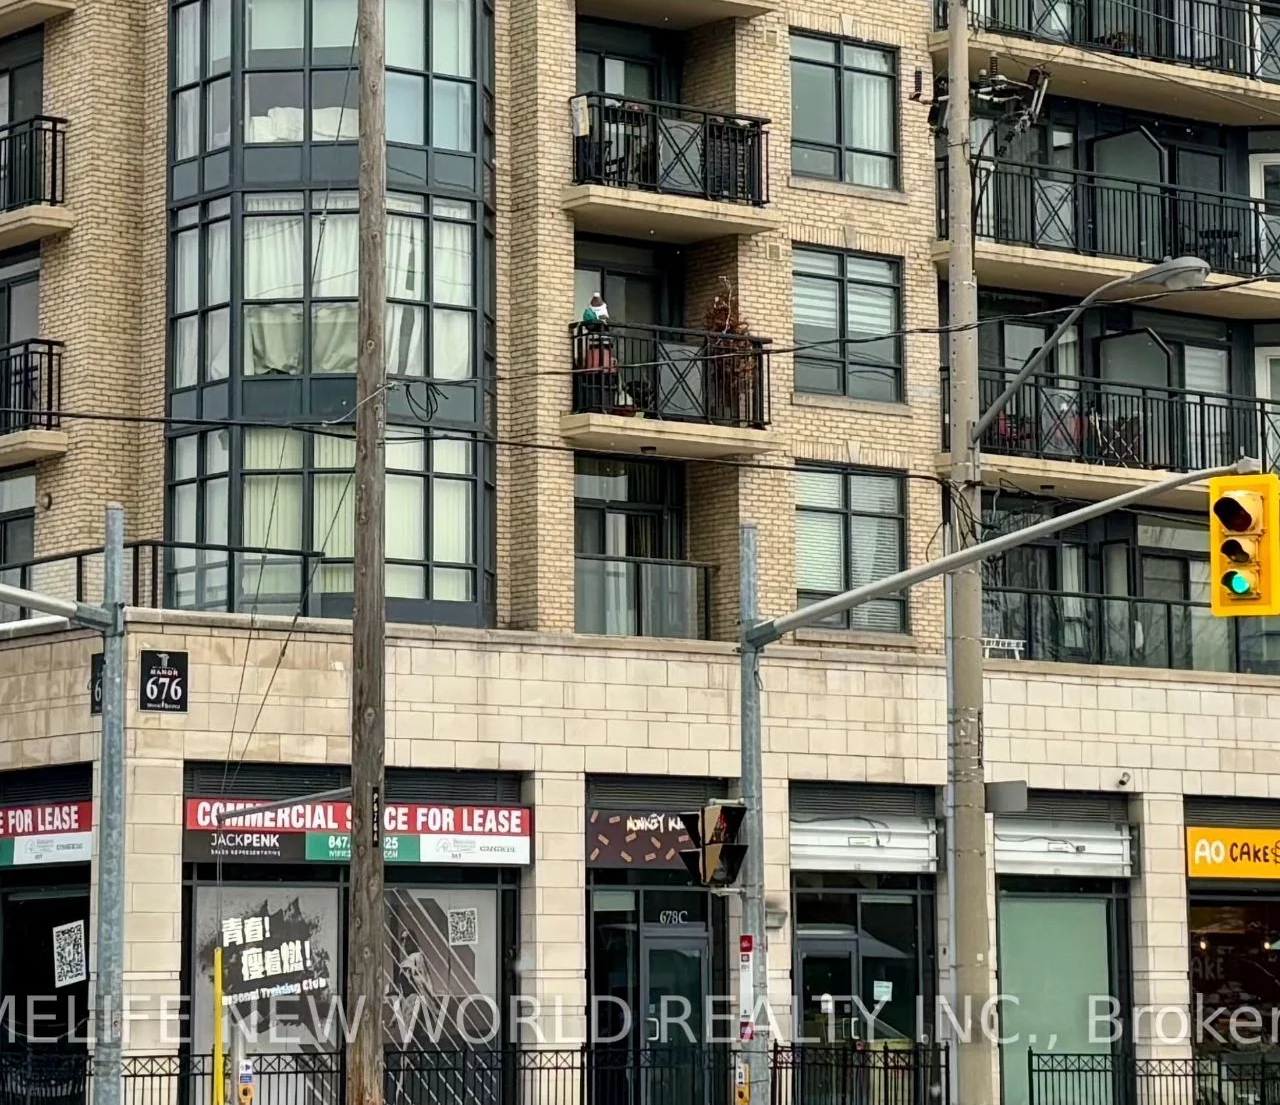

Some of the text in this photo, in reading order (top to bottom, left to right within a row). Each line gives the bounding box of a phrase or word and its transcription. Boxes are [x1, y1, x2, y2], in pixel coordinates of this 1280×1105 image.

[150, 669, 179, 677] MANOR
[146, 676, 182, 701] 676
[7, 808, 33, 834] FOR
[37, 805, 79, 831] LEASE
[197, 801, 339, 830] COMMERCIAL
[416, 807, 455, 832] FOR
[462, 808, 522, 833] LEASE
[1194, 838, 1270, 864] AO CAKE
